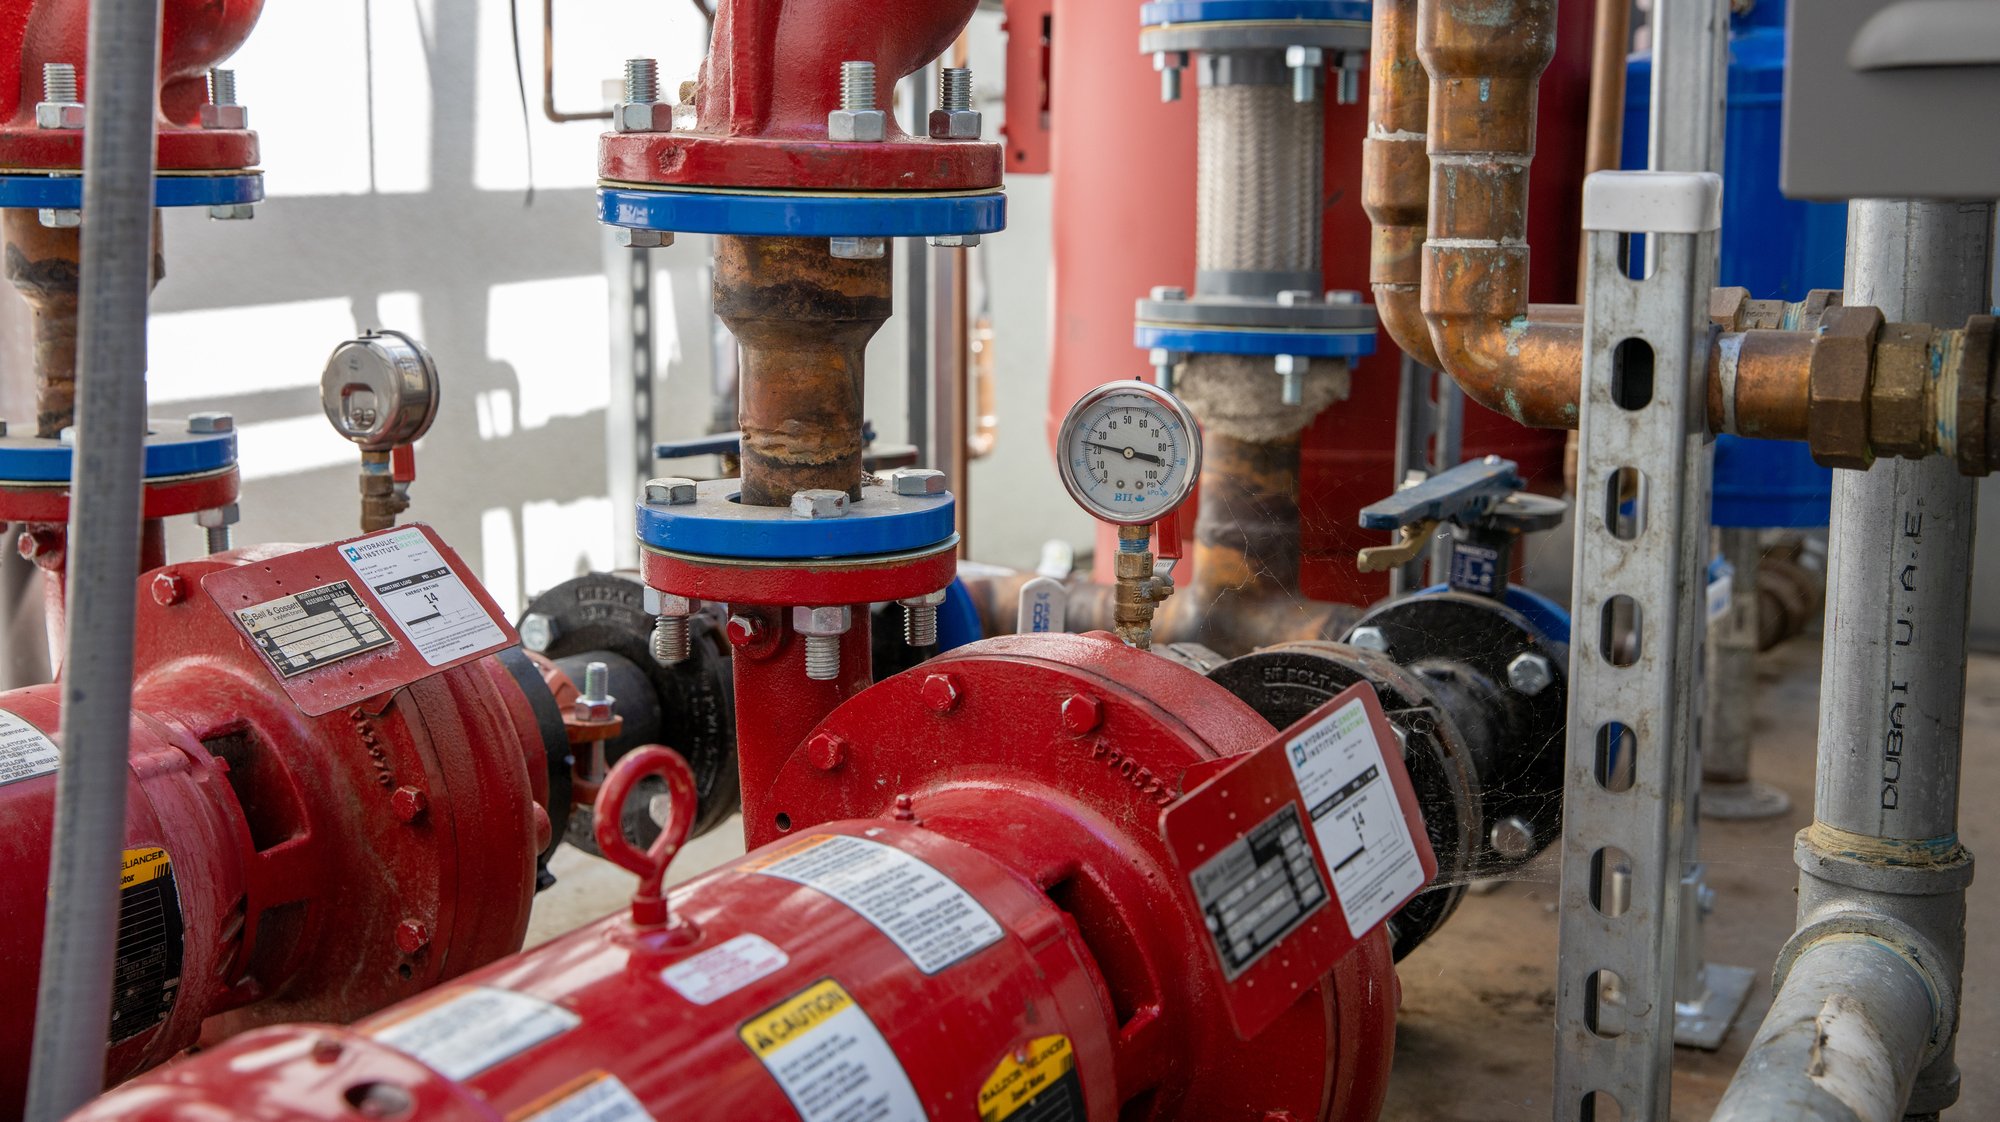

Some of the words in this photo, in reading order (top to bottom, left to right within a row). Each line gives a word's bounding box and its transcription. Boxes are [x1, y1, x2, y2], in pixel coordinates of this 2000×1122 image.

[1108, 421, 1117, 430] 40
[1123, 416, 1132, 425] 50
[1139, 419, 1148, 428] 60
[1098, 431, 1107, 440] 30
[1151, 429, 1159, 438] 70
[1093, 446, 1102, 455] 20
[1158, 443, 1167, 452] 80
[1097, 460, 1105, 469] 10
[1157, 459, 1165, 467] 90
[1103, 470, 1108, 479] 0
[1145, 470, 1157, 479] 100
[358, 538, 395, 553] HYDRAULIC
[363, 544, 400, 559] INSTITUTE
[424, 592, 439, 604] 14
[273, 601, 300, 614] Gossett
[1304, 720, 1338, 747] HYDRAULIC
[12, 742, 40, 752] BEFORE
[1308, 731, 1341, 757] INSTITUTE
[1881, 681, 1909, 810] DUBAI
[12, 761, 36, 771] COULD
[35, 755, 59, 766] RESULT
[1352, 811, 1365, 831] 14
[120, 874, 134, 884] otor
[769, 990, 845, 1040] CAUTION
